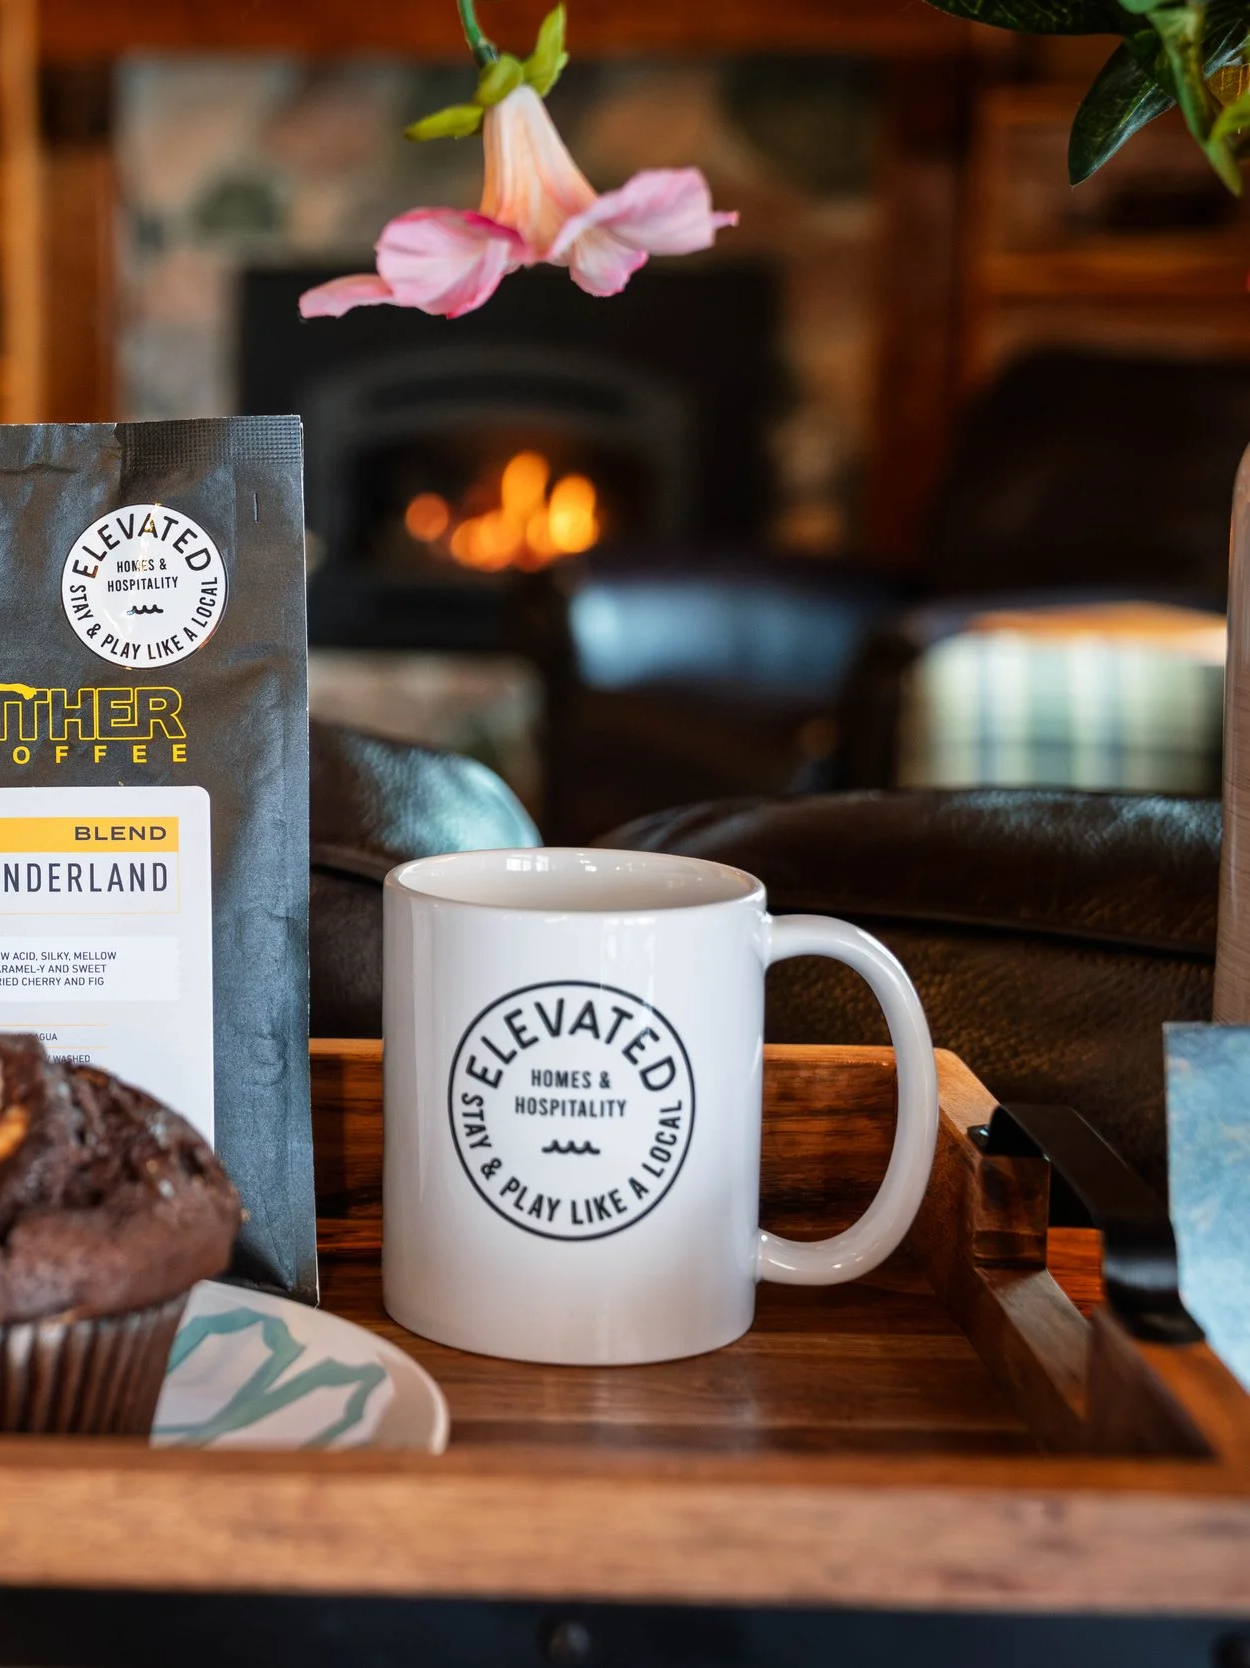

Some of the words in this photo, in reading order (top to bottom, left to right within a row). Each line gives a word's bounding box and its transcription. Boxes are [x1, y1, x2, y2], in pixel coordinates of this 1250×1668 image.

[72, 512, 212, 579] ELEVATED
[116, 559, 155, 573] HOMES
[159, 557, 167, 571] &
[107, 576, 179, 592] HOSPITALITY
[69, 584, 94, 621] STAY
[86, 623, 101, 639] &
[100, 633, 141, 660] PLAY
[147, 634, 184, 660] LIKE
[183, 626, 198, 642] A
[191, 577, 218, 628] LOCAL
[74, 825, 168, 841] BLEND
[12, 951, 38, 962] ACID,
[41, 951, 71, 962] SILKY,
[73, 951, 117, 961] MELLOW
[47, 964, 70, 974] AND
[72, 964, 107, 973] SWEET
[21, 977, 61, 987] CHERRY
[64, 977, 86, 986] AND
[88, 976, 105, 986] FIG
[465, 997, 677, 1093] ELEVATED
[52, 1054, 91, 1064] WASHED
[531, 1069, 592, 1089] HOMES
[599, 1070, 611, 1089] &
[514, 1096, 626, 1117] HOSPITALITY
[461, 1092, 492, 1150] STAY
[480, 1157, 502, 1181] &
[499, 1176, 561, 1223] PLAY
[571, 1188, 628, 1226] LIKE
[628, 1176, 650, 1200] A
[641, 1099, 683, 1178] LOCAL
